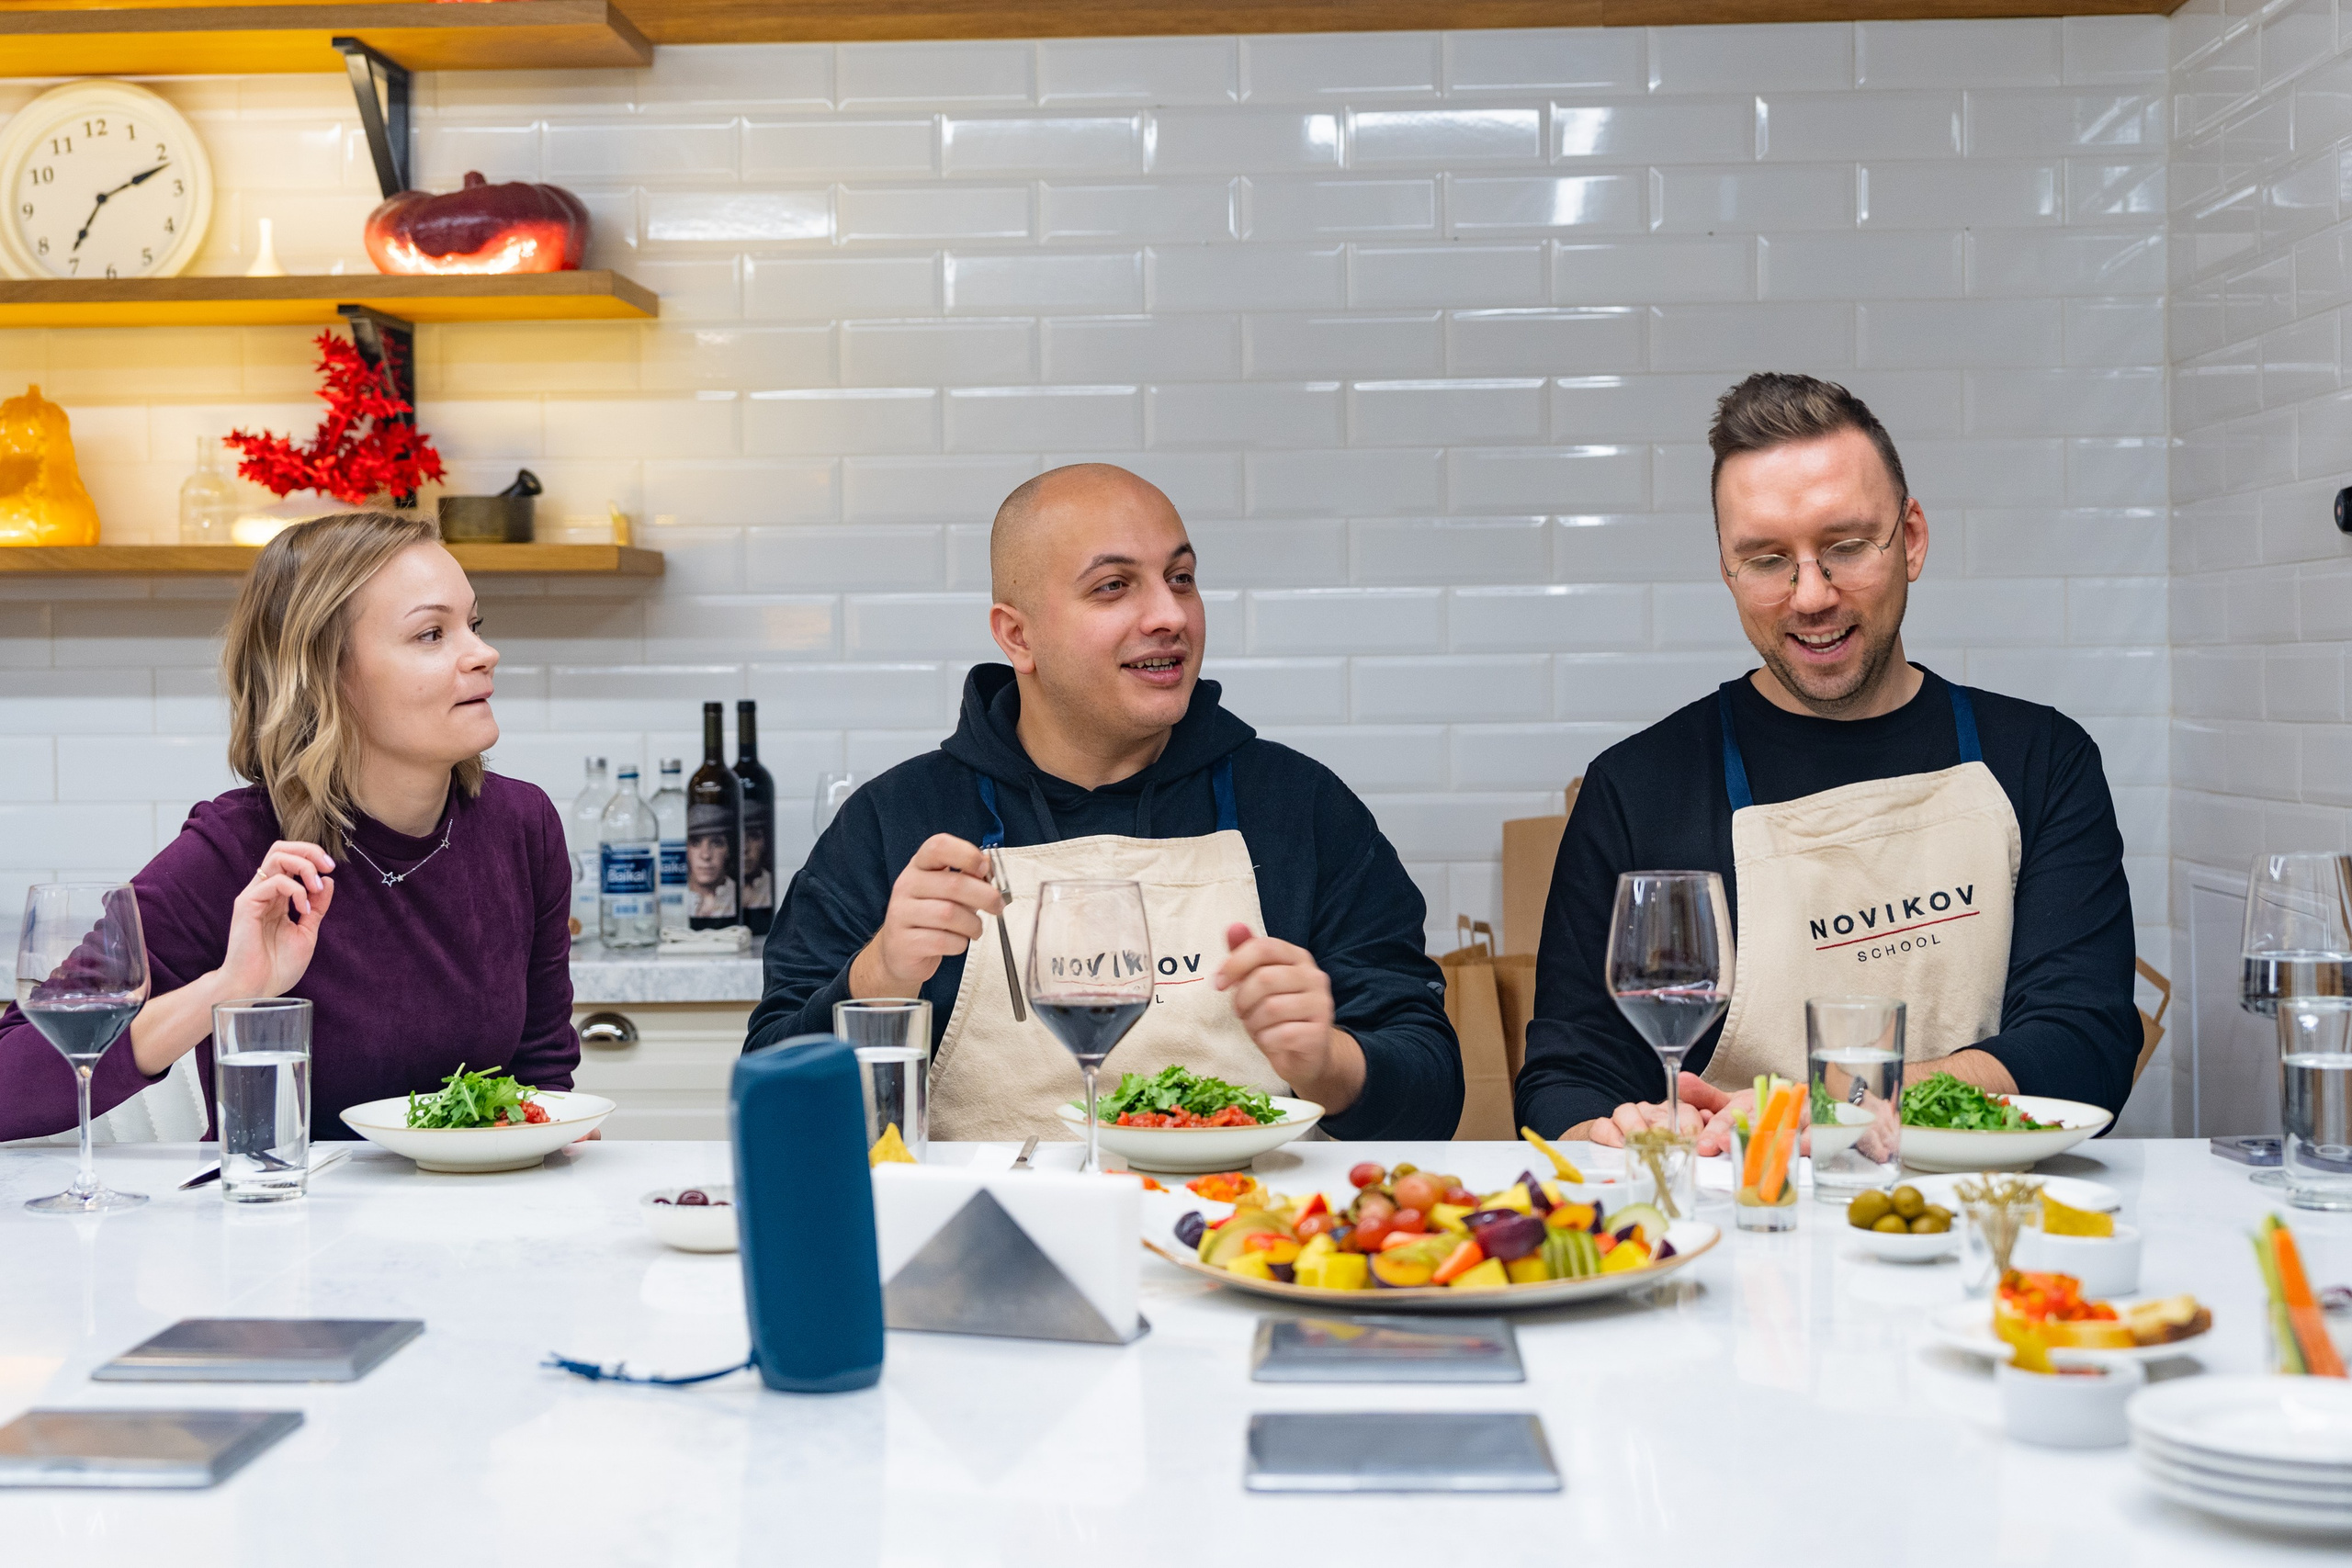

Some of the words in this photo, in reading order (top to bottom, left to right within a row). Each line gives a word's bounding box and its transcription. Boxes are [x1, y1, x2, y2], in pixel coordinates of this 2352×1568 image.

[84, 118, 107, 138] 12
[126, 124, 135, 141] 1
[51, 136, 73, 155] 11
[156, 143, 167, 161] 2
[30, 166, 54, 185] 10
[173, 179, 184, 197] 3
[23, 203, 34, 220] 9
[164, 217, 175, 234] 4
[38, 237, 50, 255] 8
[141, 248, 153, 266] 5
[68, 258, 80, 275] 7
[106, 263, 118, 279] 6
[1807, 884, 1973, 940] NOVIKOV
[1857, 934, 1941, 963] SCHOOL
